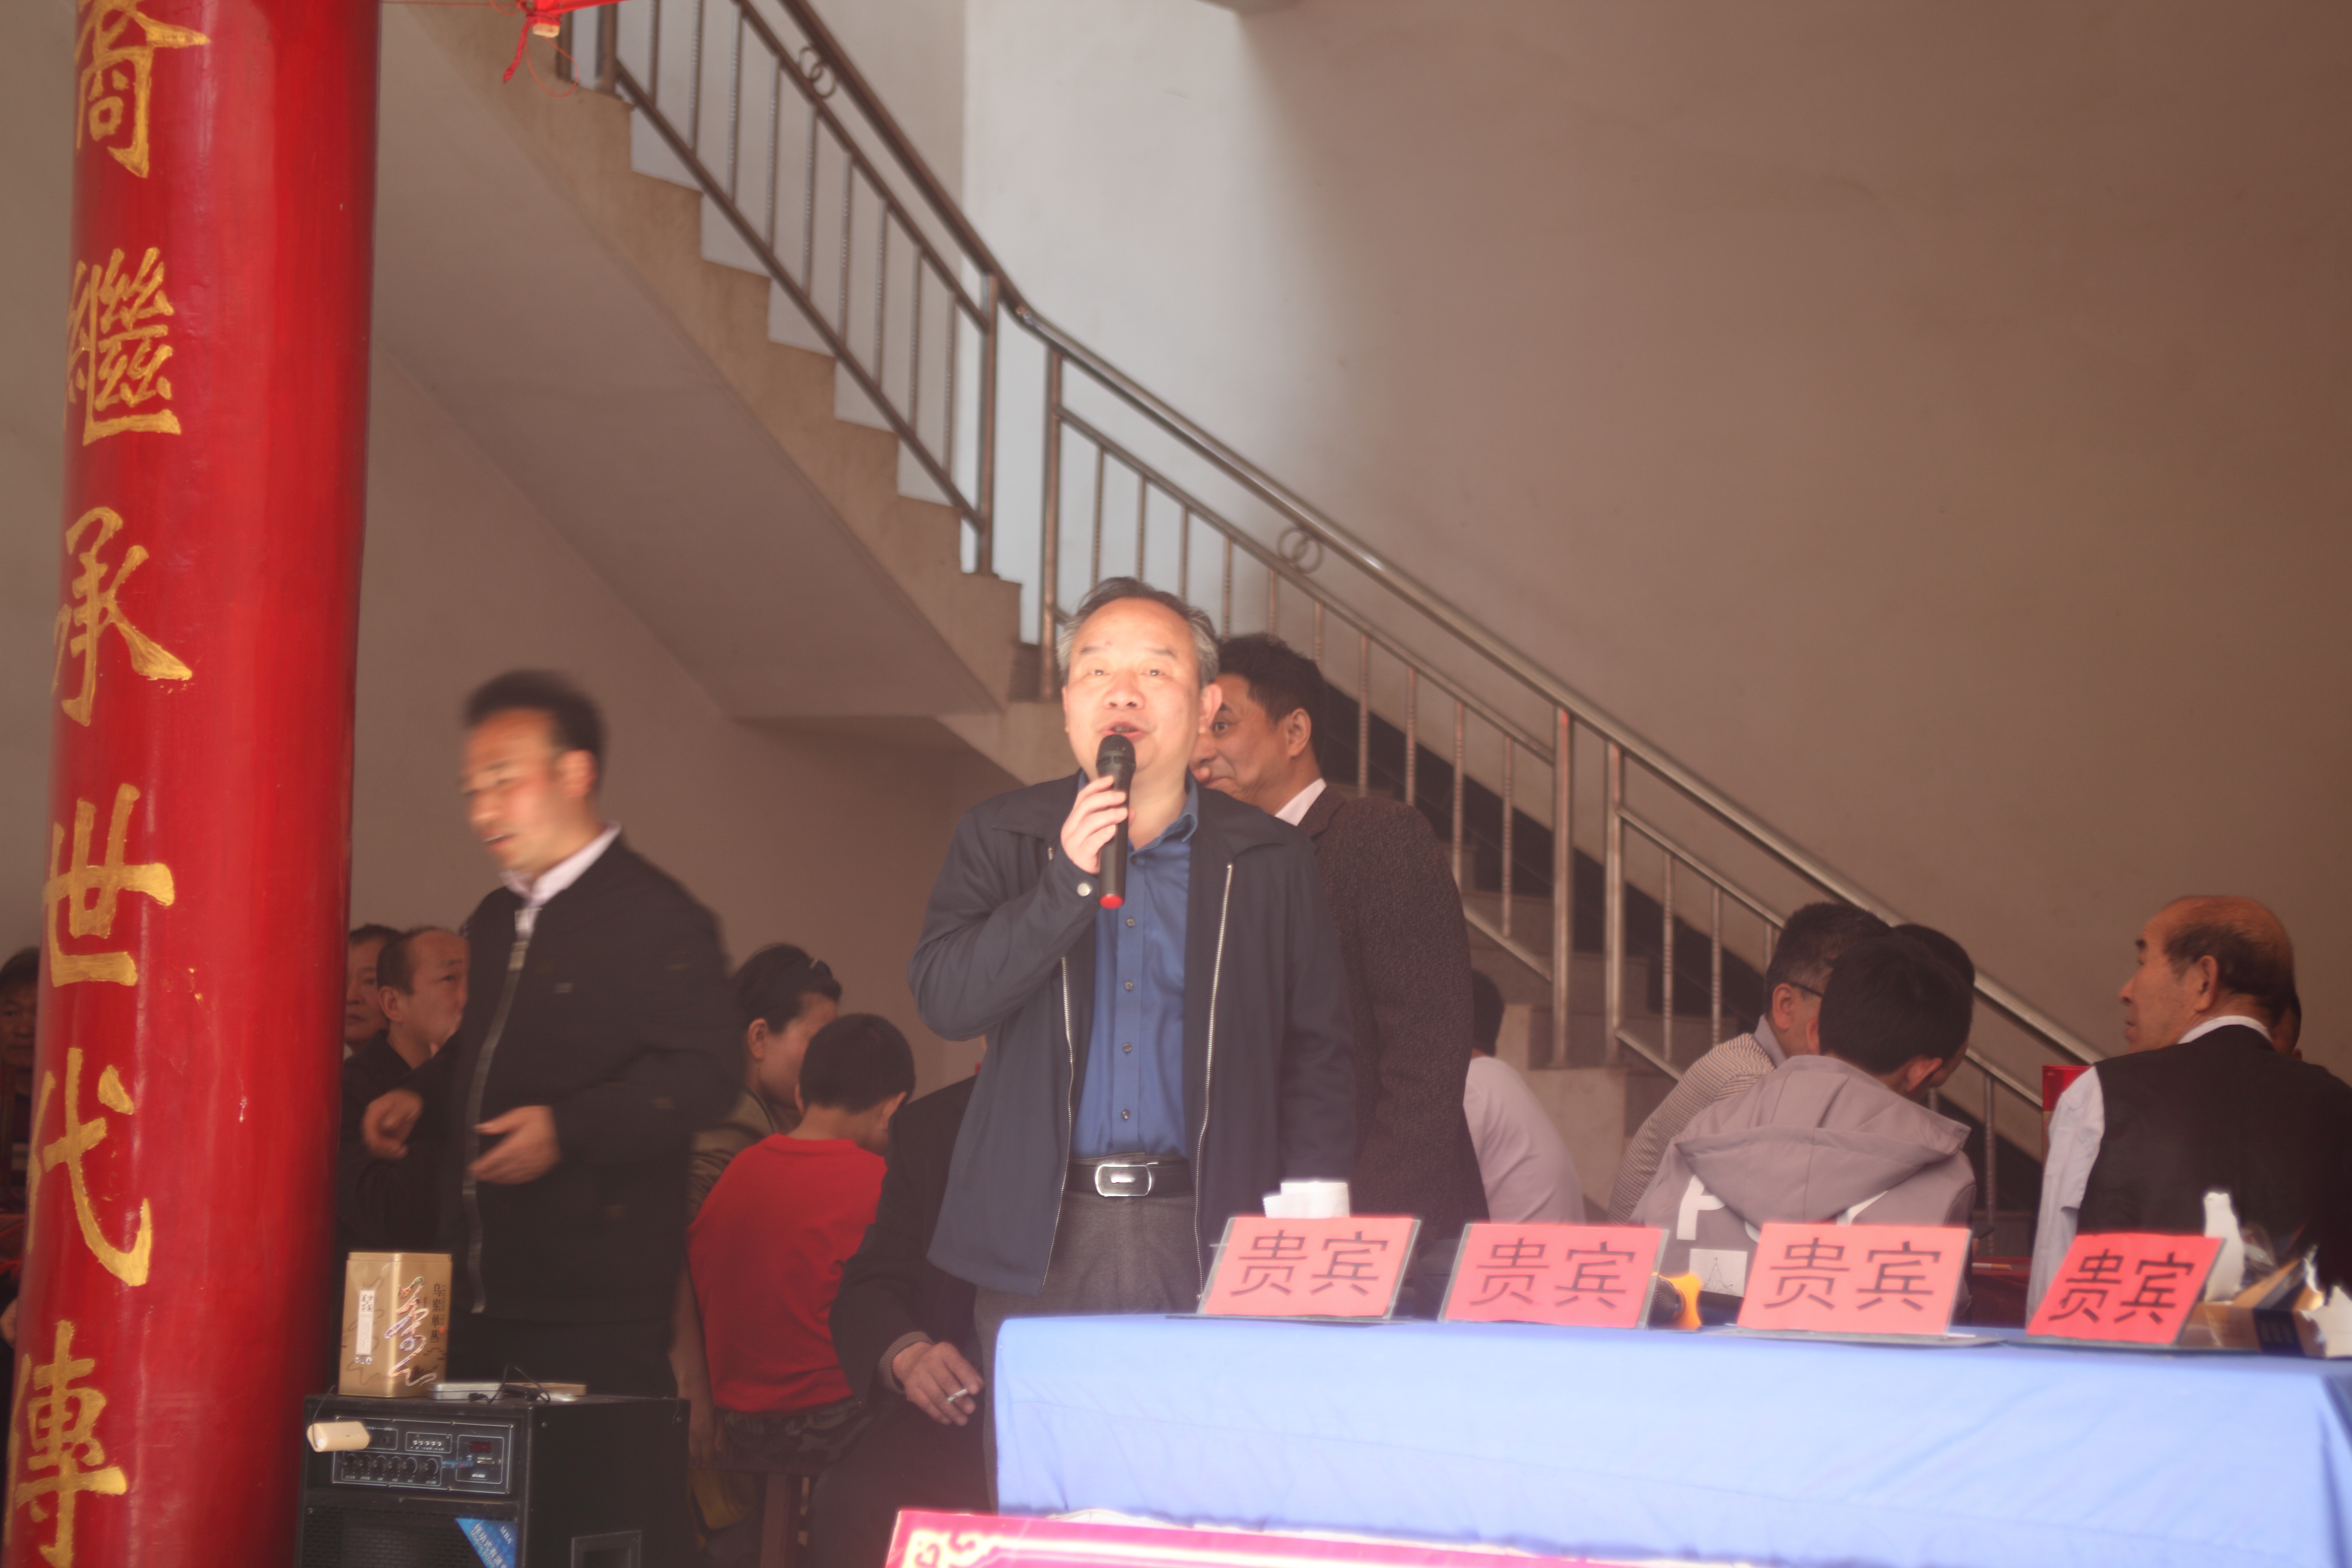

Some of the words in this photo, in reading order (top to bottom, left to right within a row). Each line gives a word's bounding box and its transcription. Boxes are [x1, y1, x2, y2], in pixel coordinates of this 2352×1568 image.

[1229, 1230, 1389, 1297] 贵宾
[1469, 1238, 1636, 1310] 贵宾
[1763, 1237, 1942, 1311] 贵宾
[2048, 1248, 2195, 1325] 贵宾
[469, 1529, 483, 1551] Mobile
